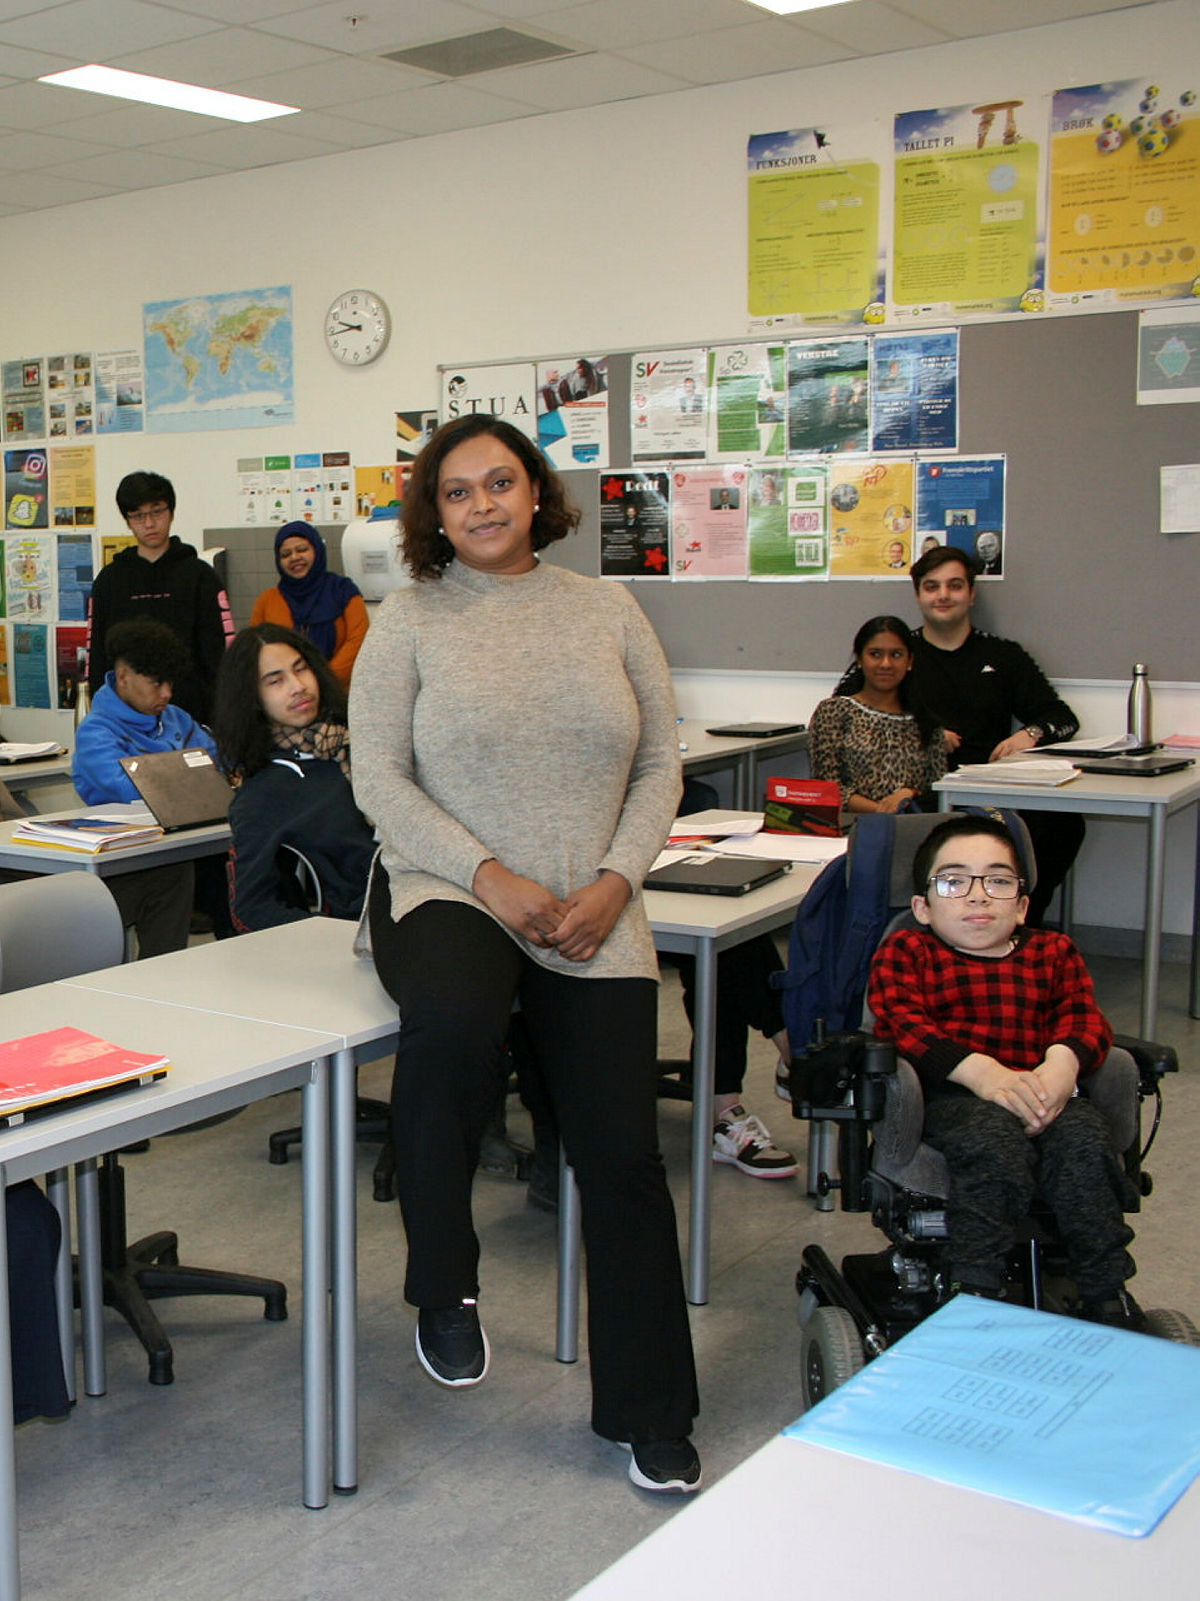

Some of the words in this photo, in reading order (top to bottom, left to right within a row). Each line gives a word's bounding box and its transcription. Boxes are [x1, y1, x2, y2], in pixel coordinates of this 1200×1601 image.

[904, 138, 940, 152] TALLET
[944, 136, 955, 147] PI
[756, 154, 817, 170] FUNKSJONER
[636, 361, 660, 378] SV
[675, 560, 693, 572] SV
